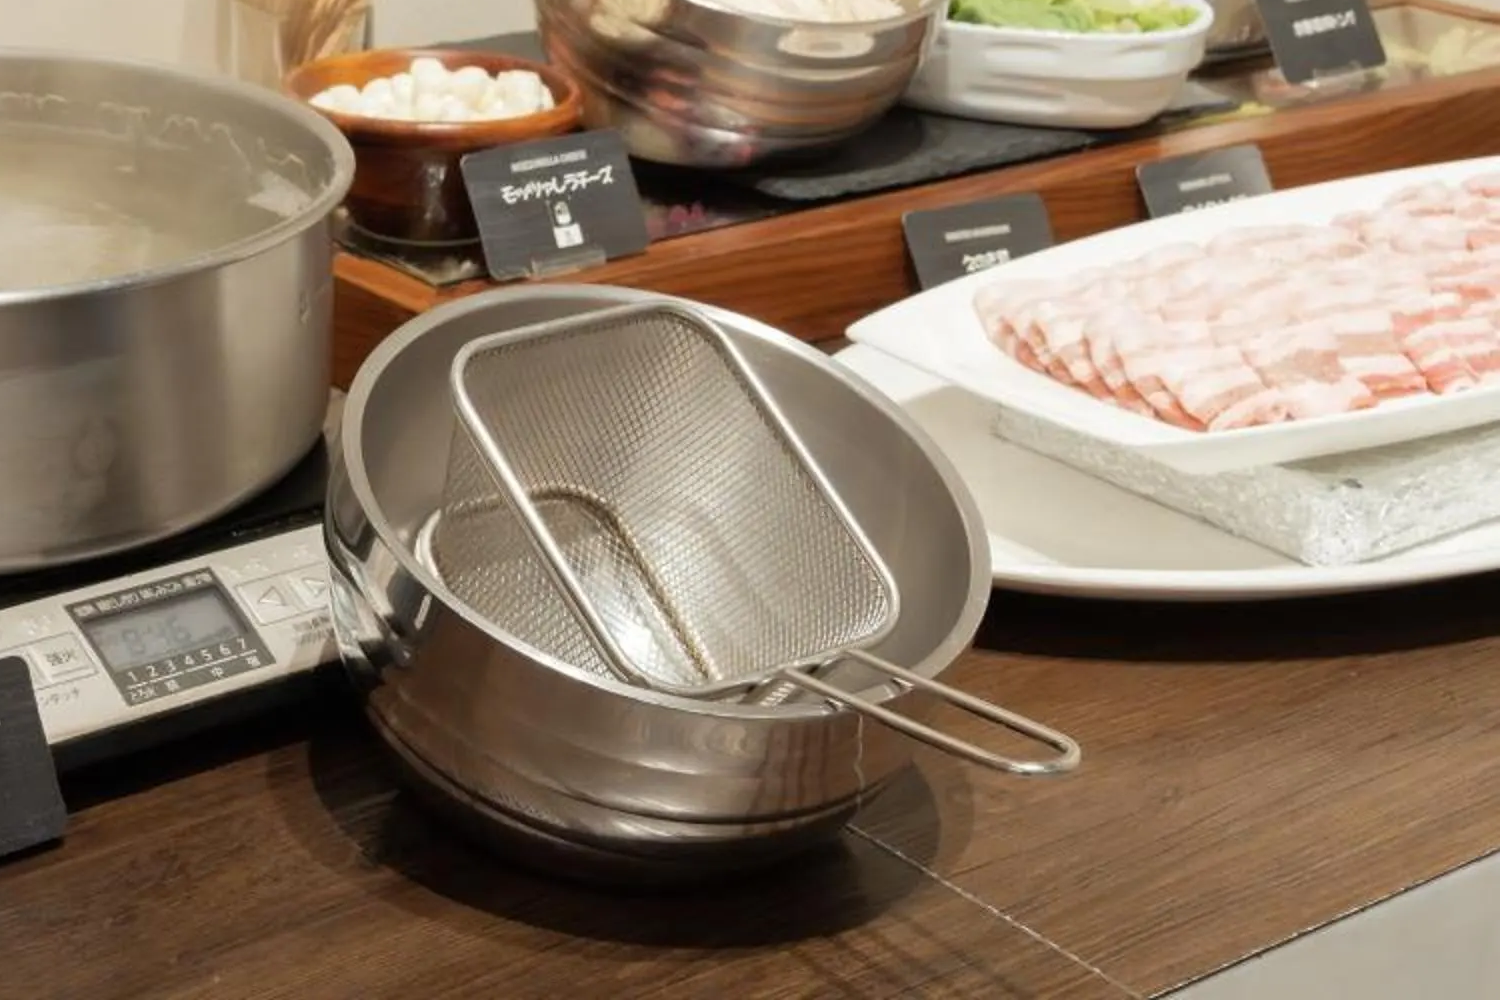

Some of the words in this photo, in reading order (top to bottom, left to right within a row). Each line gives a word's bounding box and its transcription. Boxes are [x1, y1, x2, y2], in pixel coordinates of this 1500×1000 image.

[127, 670, 139, 682] 1
[146, 665, 159, 677] 2
[164, 660, 177, 673] 3
[184, 655, 195, 665] 4
[200, 649, 213, 661] 5
[219, 643, 231, 655] 6
[236, 637, 246, 650] 7
